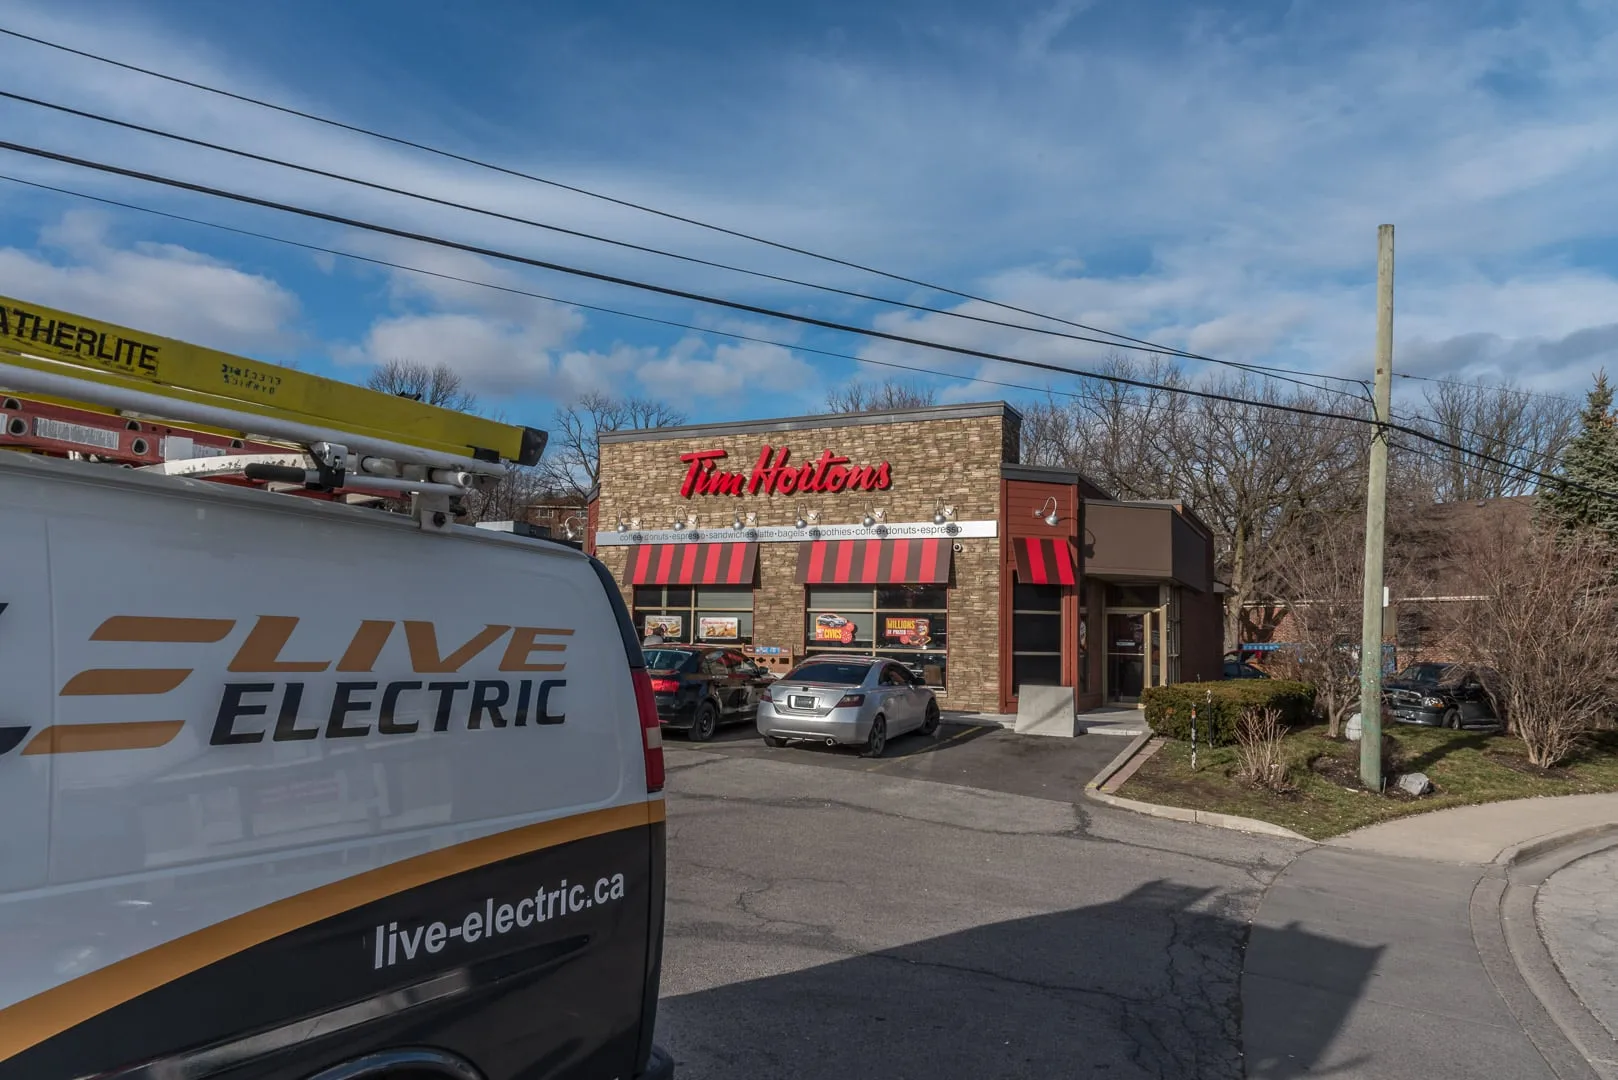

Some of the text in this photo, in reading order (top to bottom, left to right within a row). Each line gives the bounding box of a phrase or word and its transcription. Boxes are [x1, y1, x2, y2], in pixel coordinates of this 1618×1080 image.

[680, 444, 892, 499] Tim Hortons
[619, 534, 642, 542] coffee
[709, 531, 754, 541] sandwiches
[777, 528, 804, 539] bagels
[808, 528, 852, 538] smoothies
[855, 527, 882, 536] coffee
[886, 526, 917, 535] donuts
[920, 525, 963, 537] espresso
[227, 614, 576, 673] LIVE
[824, 629, 842, 639] CIVICS
[209, 679, 567, 746] ELECTRIC
[372, 872, 626, 970] live-electric.ca
